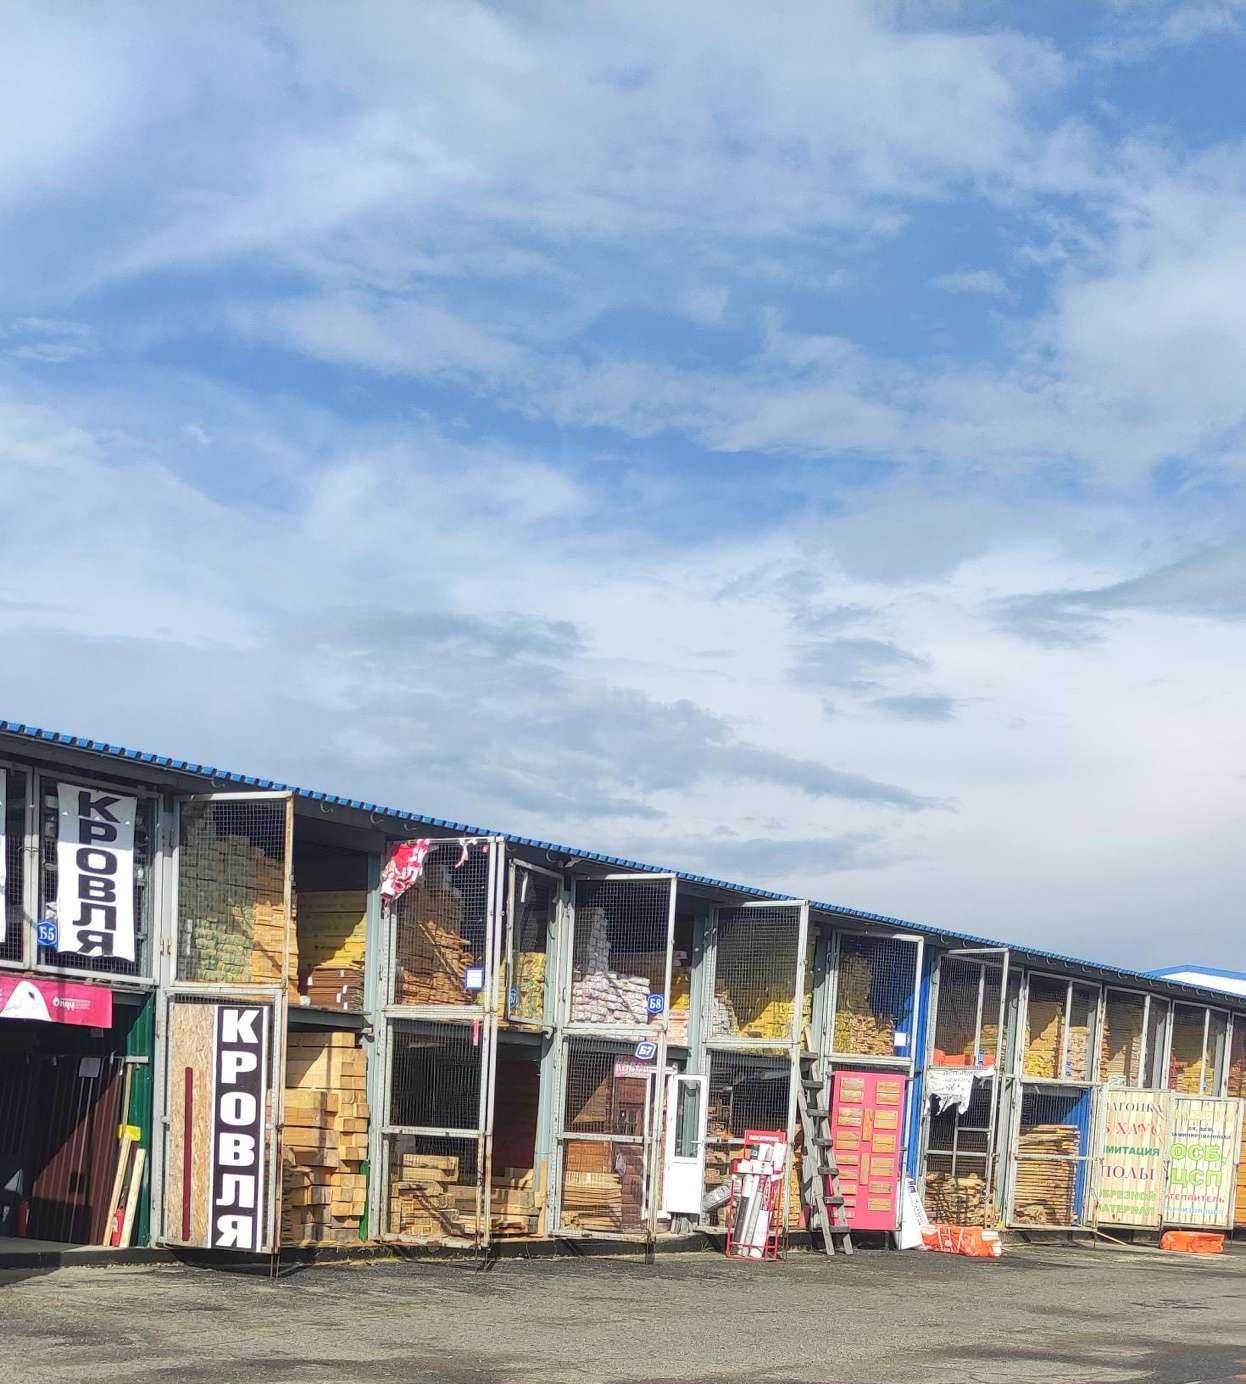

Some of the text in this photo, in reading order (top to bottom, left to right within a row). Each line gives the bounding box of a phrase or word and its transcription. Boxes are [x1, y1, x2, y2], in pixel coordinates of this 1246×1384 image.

[72, 791, 121, 956] КРОВЛЯ
[215, 1009, 260, 1248] КРОВЛЯ
[1101, 1165, 1155, 1180] ПОЛЫ
[1171, 1168, 1223, 1188] ЦСП
